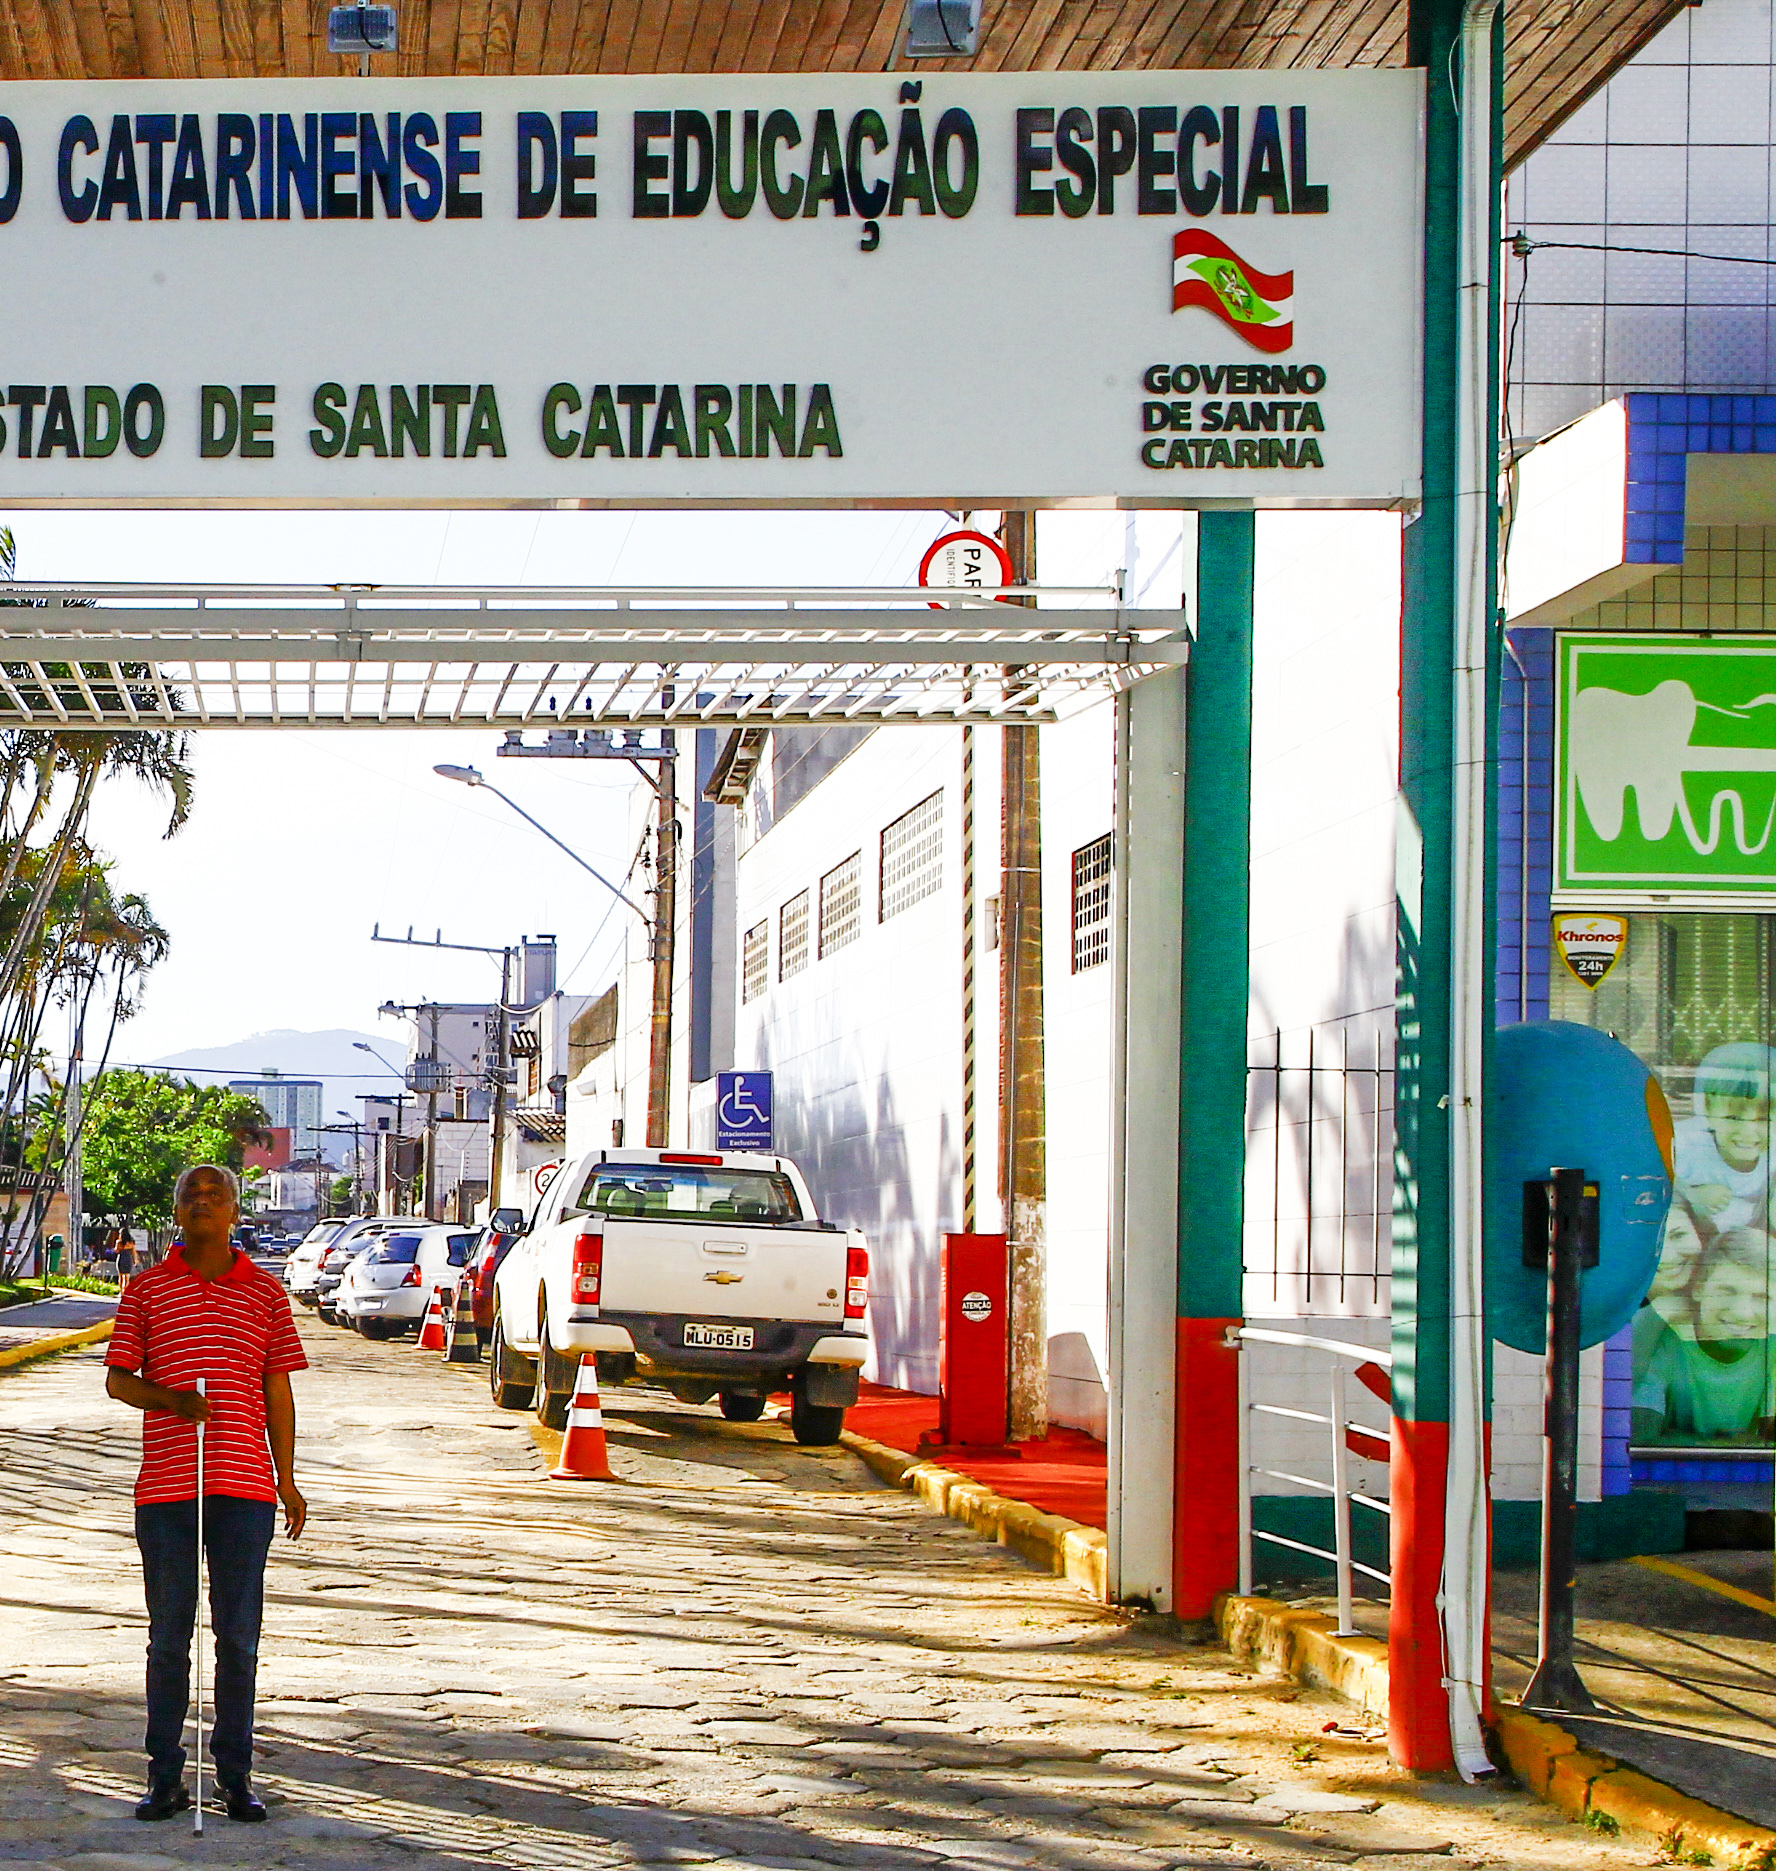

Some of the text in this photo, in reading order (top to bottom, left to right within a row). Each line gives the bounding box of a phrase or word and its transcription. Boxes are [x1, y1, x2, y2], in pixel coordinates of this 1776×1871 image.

[57, 112, 483, 224] CATARINENSE
[517, 111, 598, 220] DE
[633, 80, 981, 253] EDUCAÇÃO
[1015, 105, 1330, 219] ESPECIAL
[1142, 364, 1327, 396] GOVERNO
[200, 385, 277, 459] DE
[309, 382, 509, 460] SANTA
[542, 382, 845, 460] CATARINA
[1143, 401, 1326, 432] DE SANTA
[1141, 438, 1325, 469] CATARINA
[1557, 931, 1624, 942] Khronos
[1578, 960, 1603, 970] 24h
[719, 1130, 771, 1138] Estacionamento
[962, 1300, 992, 1311] ATENÇÃO
